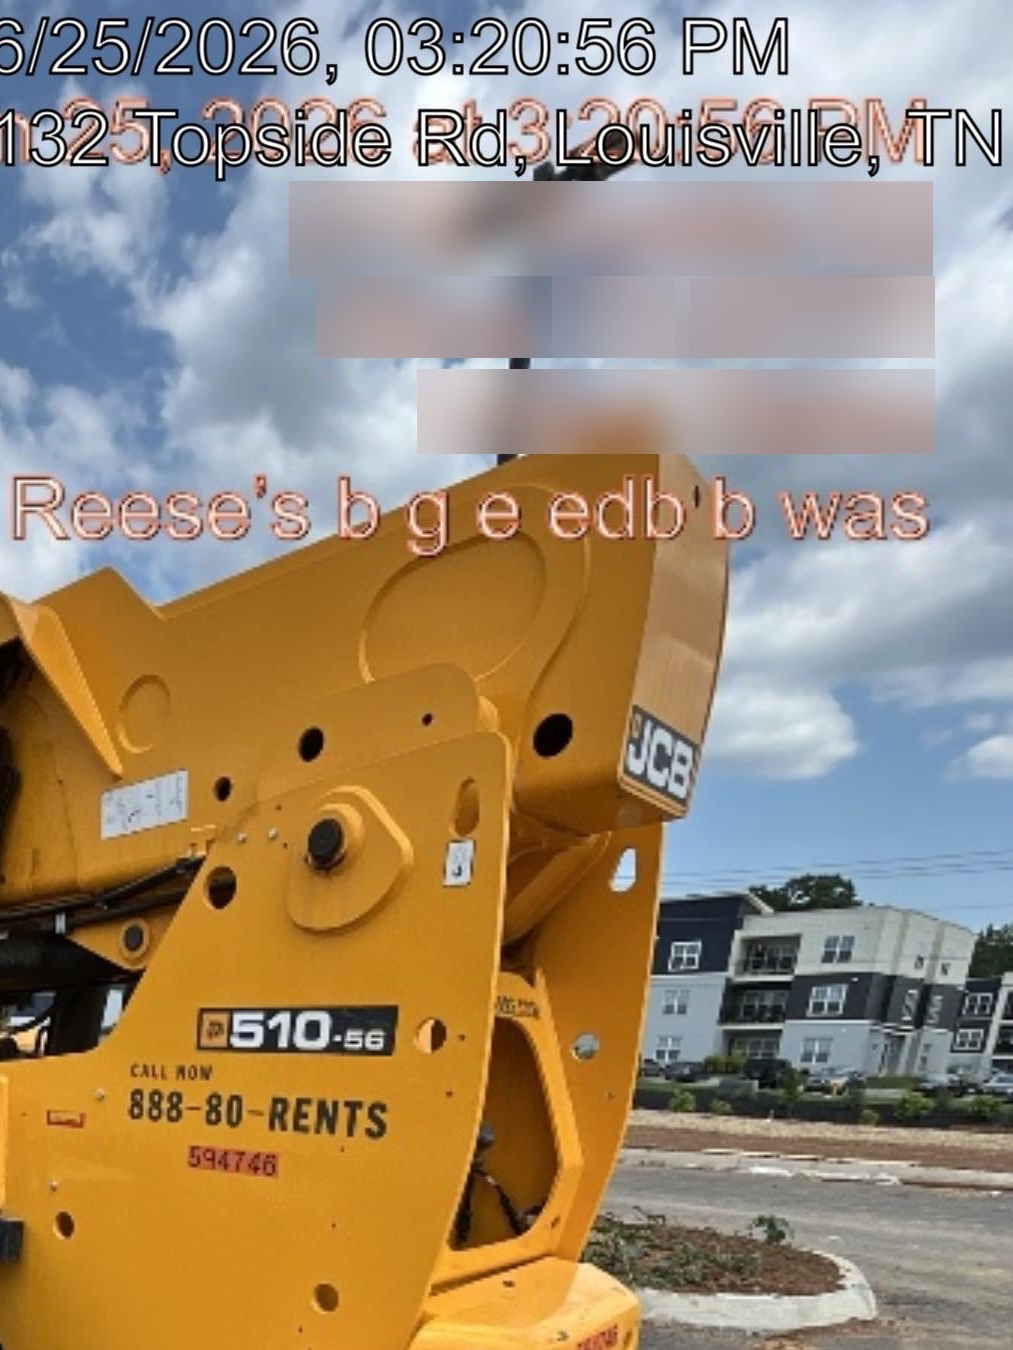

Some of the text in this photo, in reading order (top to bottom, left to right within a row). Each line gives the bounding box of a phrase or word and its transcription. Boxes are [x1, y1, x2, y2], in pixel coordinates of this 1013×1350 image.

[625, 718, 694, 799] JCB
[130, 1063, 214, 1081] CALL NOW
[128, 1088, 389, 1140] 888-80-RENTS
[188, 1145, 279, 1178] 594746
